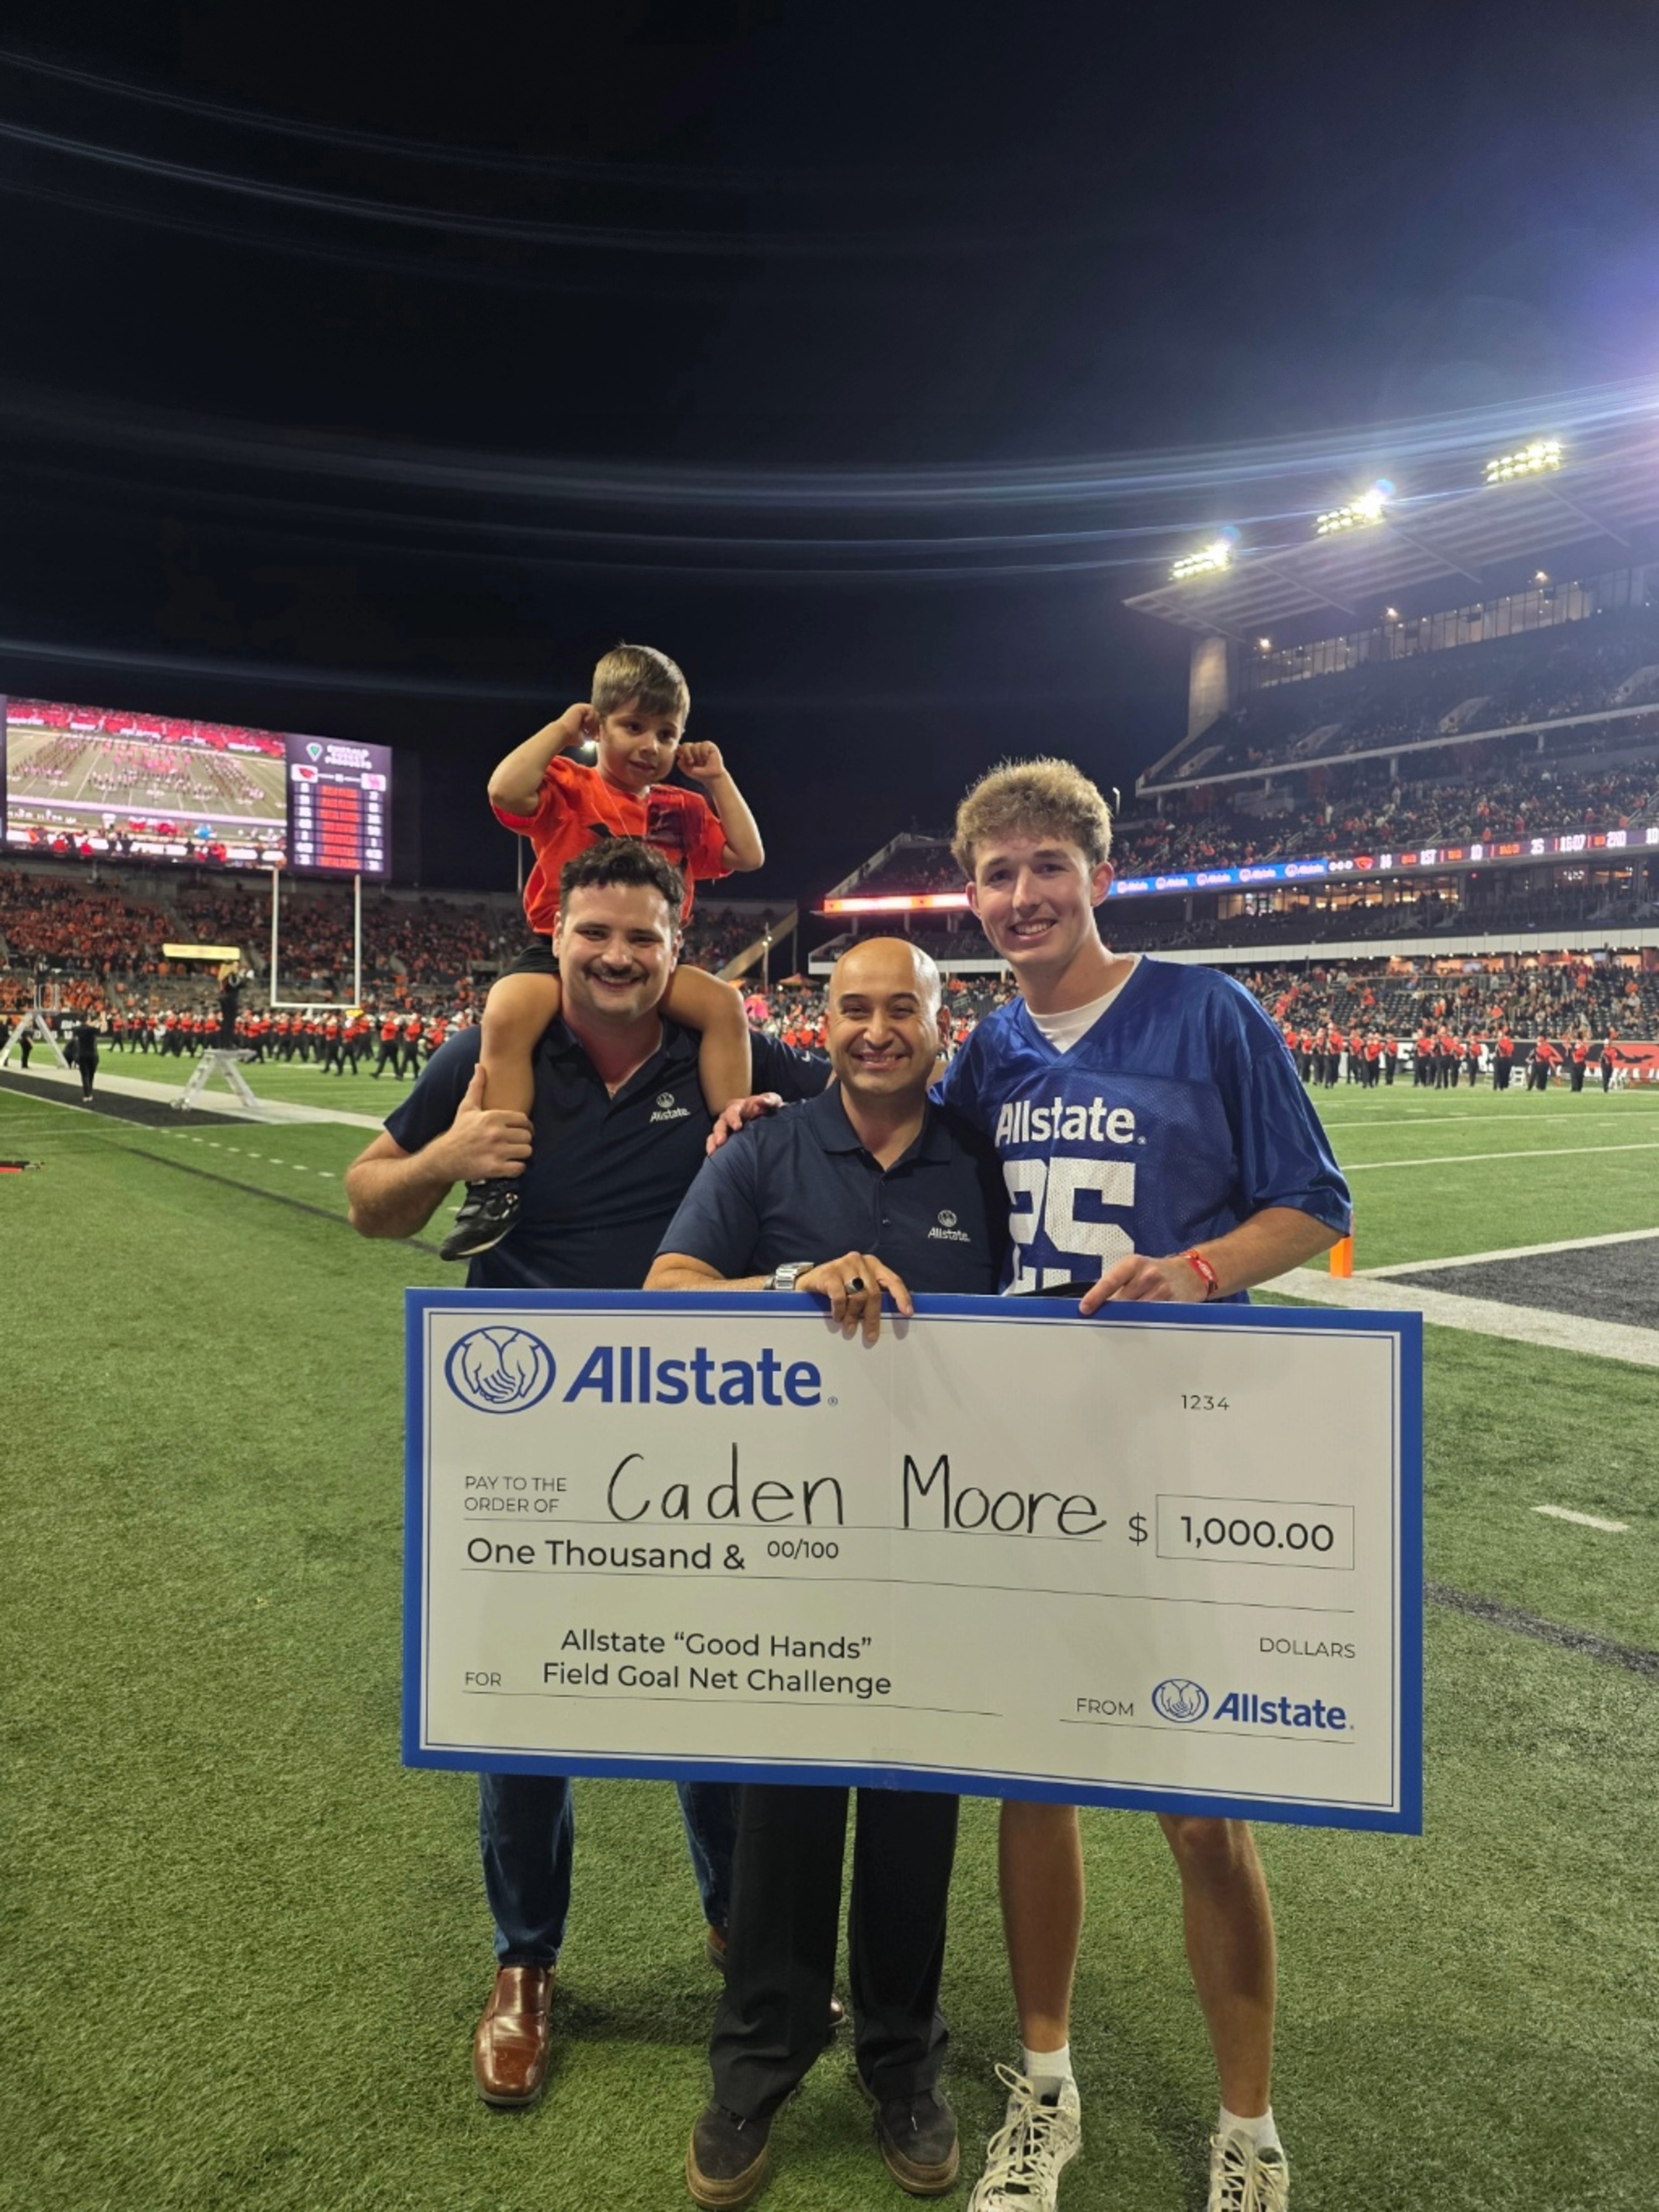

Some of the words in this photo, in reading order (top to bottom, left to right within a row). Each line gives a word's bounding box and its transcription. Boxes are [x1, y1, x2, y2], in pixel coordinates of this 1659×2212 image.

[1181, 1394, 1230, 1411] 1234
[465, 1475, 499, 1490] PAY
[502, 1476, 528, 1491] TO
[531, 1477, 567, 1492] THE
[608, 1442, 844, 1525] Caden
[904, 1454, 1108, 1536] Moore
[464, 1496, 529, 1512] ORDER
[534, 1498, 560, 1513] OF
[1128, 1511, 1149, 1547] $
[1180, 1515, 1334, 1552] 1,000.00
[467, 1537, 536, 1565] One
[544, 1538, 712, 1570] Thousand
[723, 1543, 746, 1571] &
[766, 1538, 839, 1560] 00/100
[560, 1628, 666, 1654] Allstate
[1259, 1637, 1356, 1659] DOLLARS
[465, 1671, 502, 1687] FOR
[544, 1661, 608, 1686] Field
[617, 1665, 679, 1688] Goal
[690, 1667, 739, 1690] Net
[747, 1668, 892, 1699] Challenge
[1077, 1697, 1134, 1717] FROM
